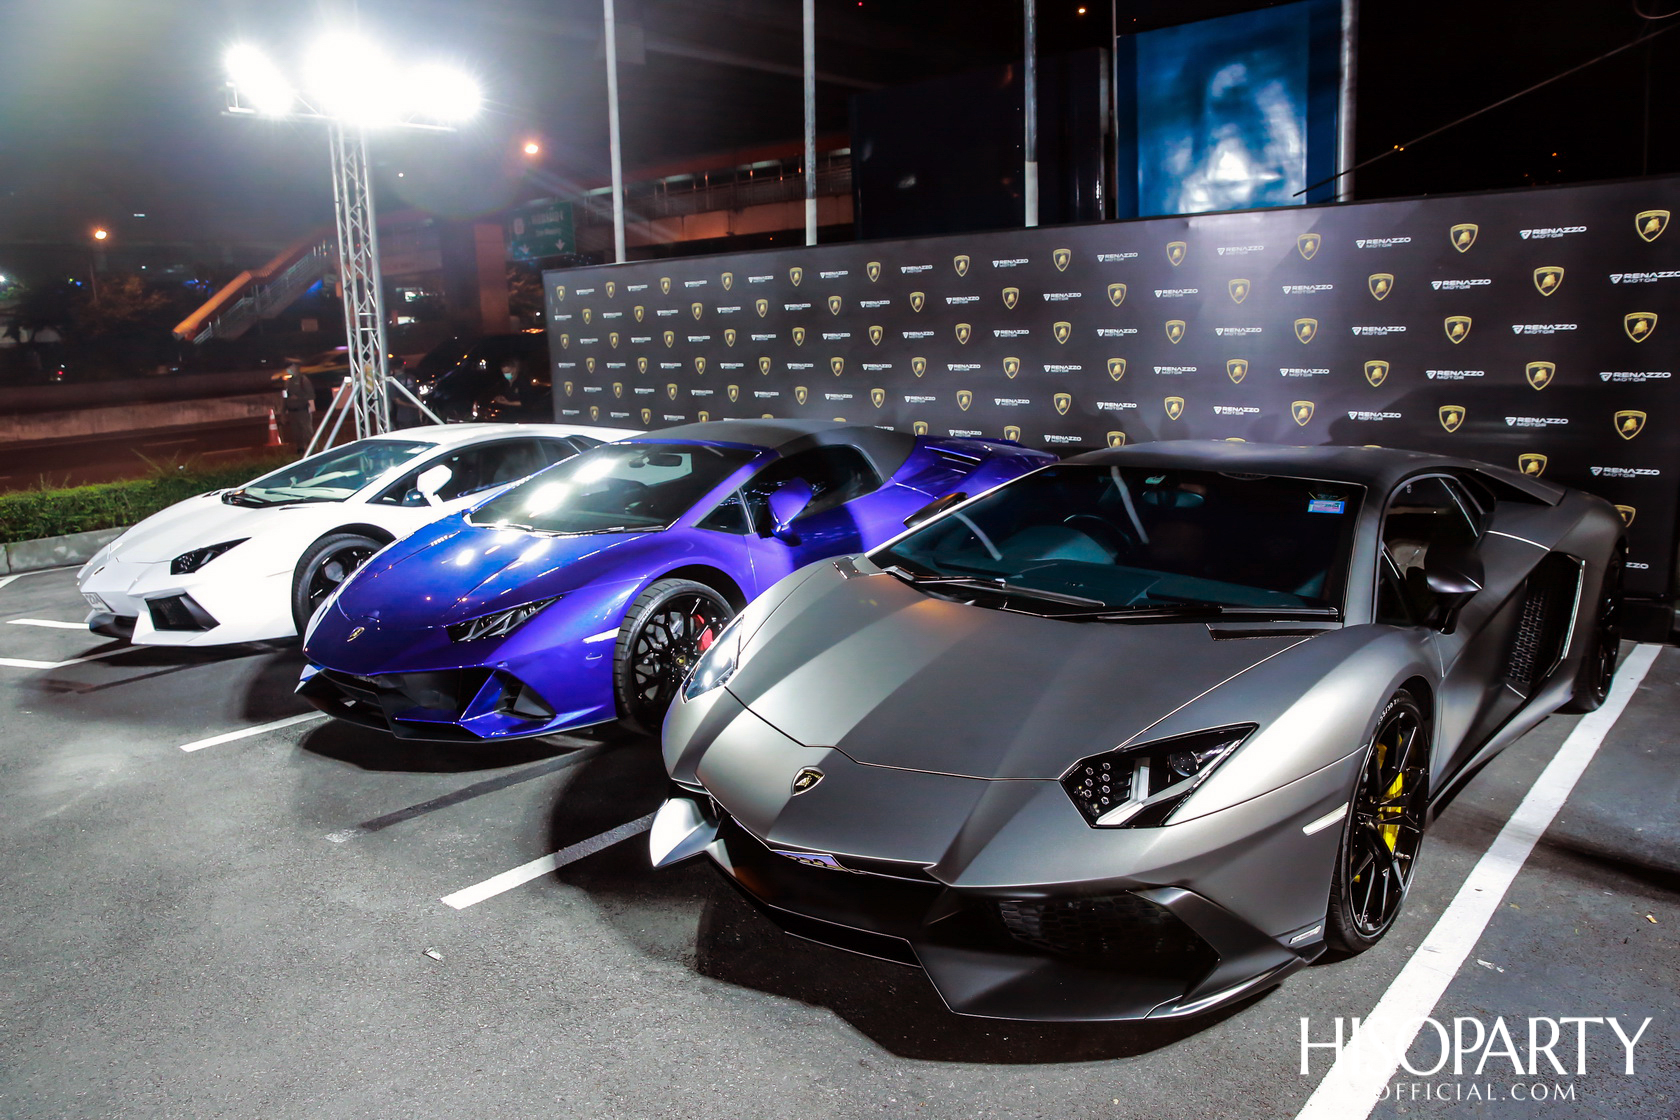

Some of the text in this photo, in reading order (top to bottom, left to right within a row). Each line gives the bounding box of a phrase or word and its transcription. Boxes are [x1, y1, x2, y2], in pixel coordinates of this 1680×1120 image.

[1532, 226, 1587, 236] RENAZZO
[1366, 237, 1411, 245] RENAZZO
[1225, 245, 1264, 253] RENAZZO
[1603, 468, 1660, 476] RENAZZO
